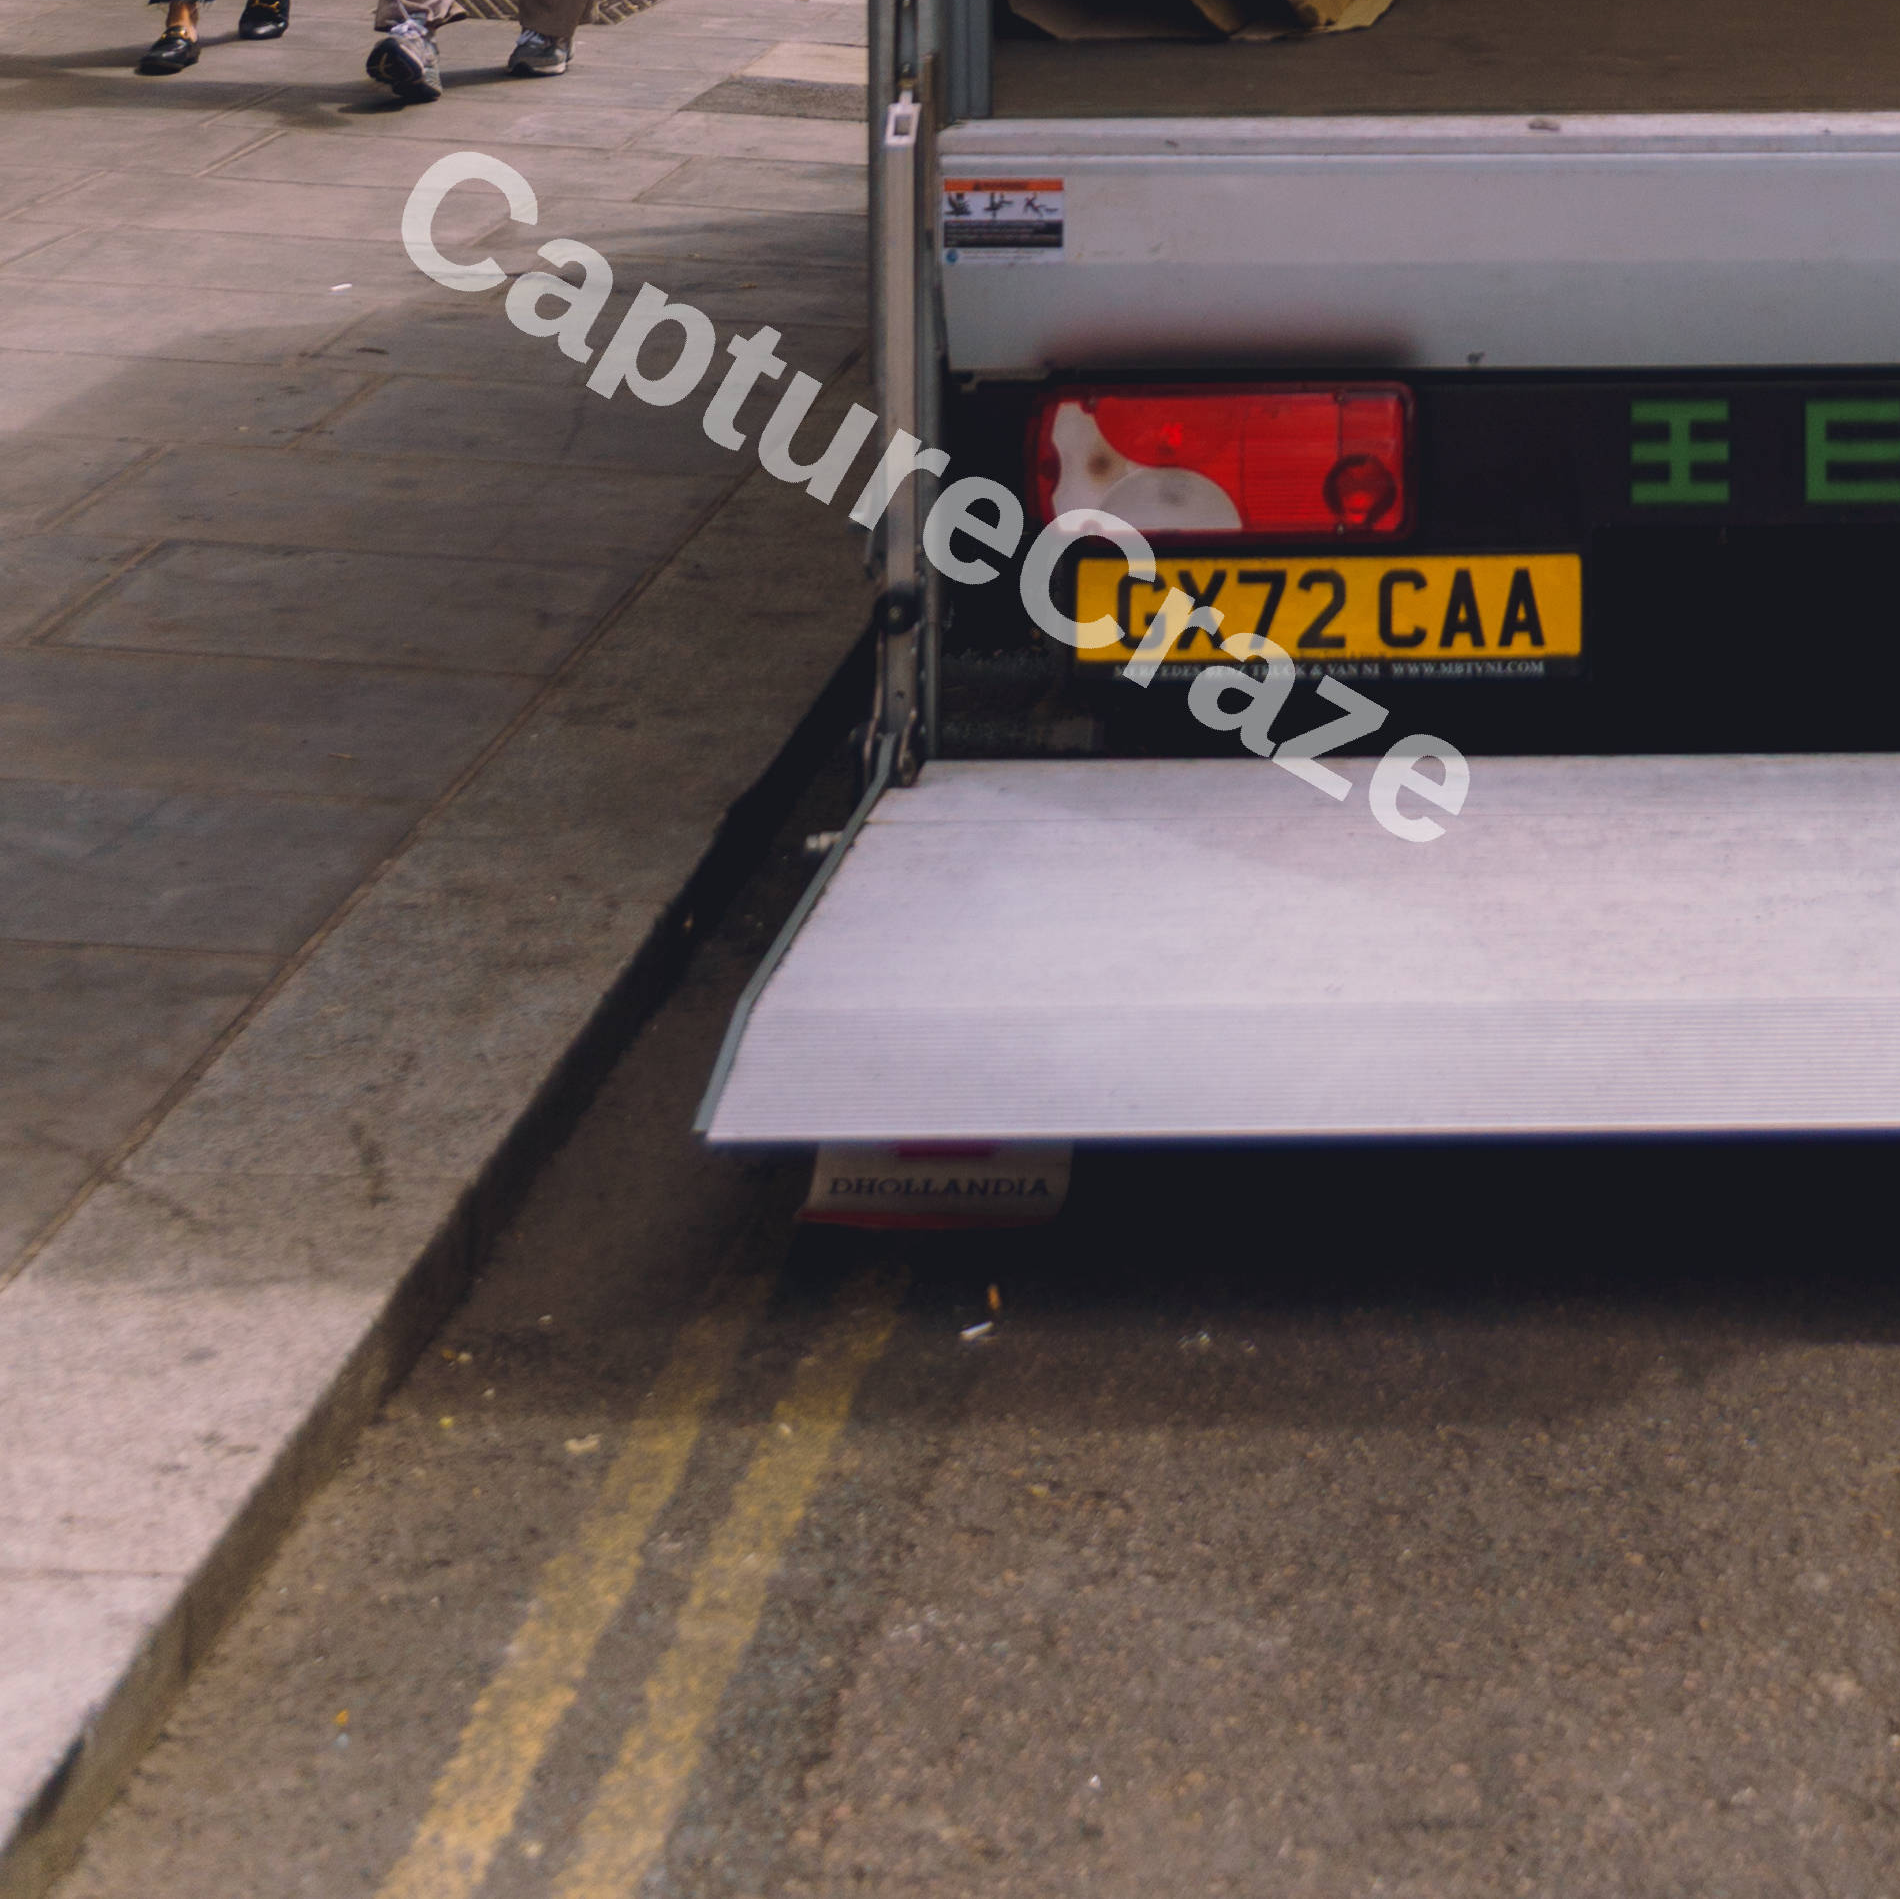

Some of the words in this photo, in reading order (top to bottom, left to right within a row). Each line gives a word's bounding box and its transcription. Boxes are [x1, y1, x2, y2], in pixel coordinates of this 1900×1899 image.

[1116, 568, 1347, 650] GX72
[1378, 567, 1545, 648] CAA
[1310, 663, 1322, 676] &
[1326, 662, 1358, 675] VAN
[829, 1176, 1050, 1197] DHOLLANDIA
